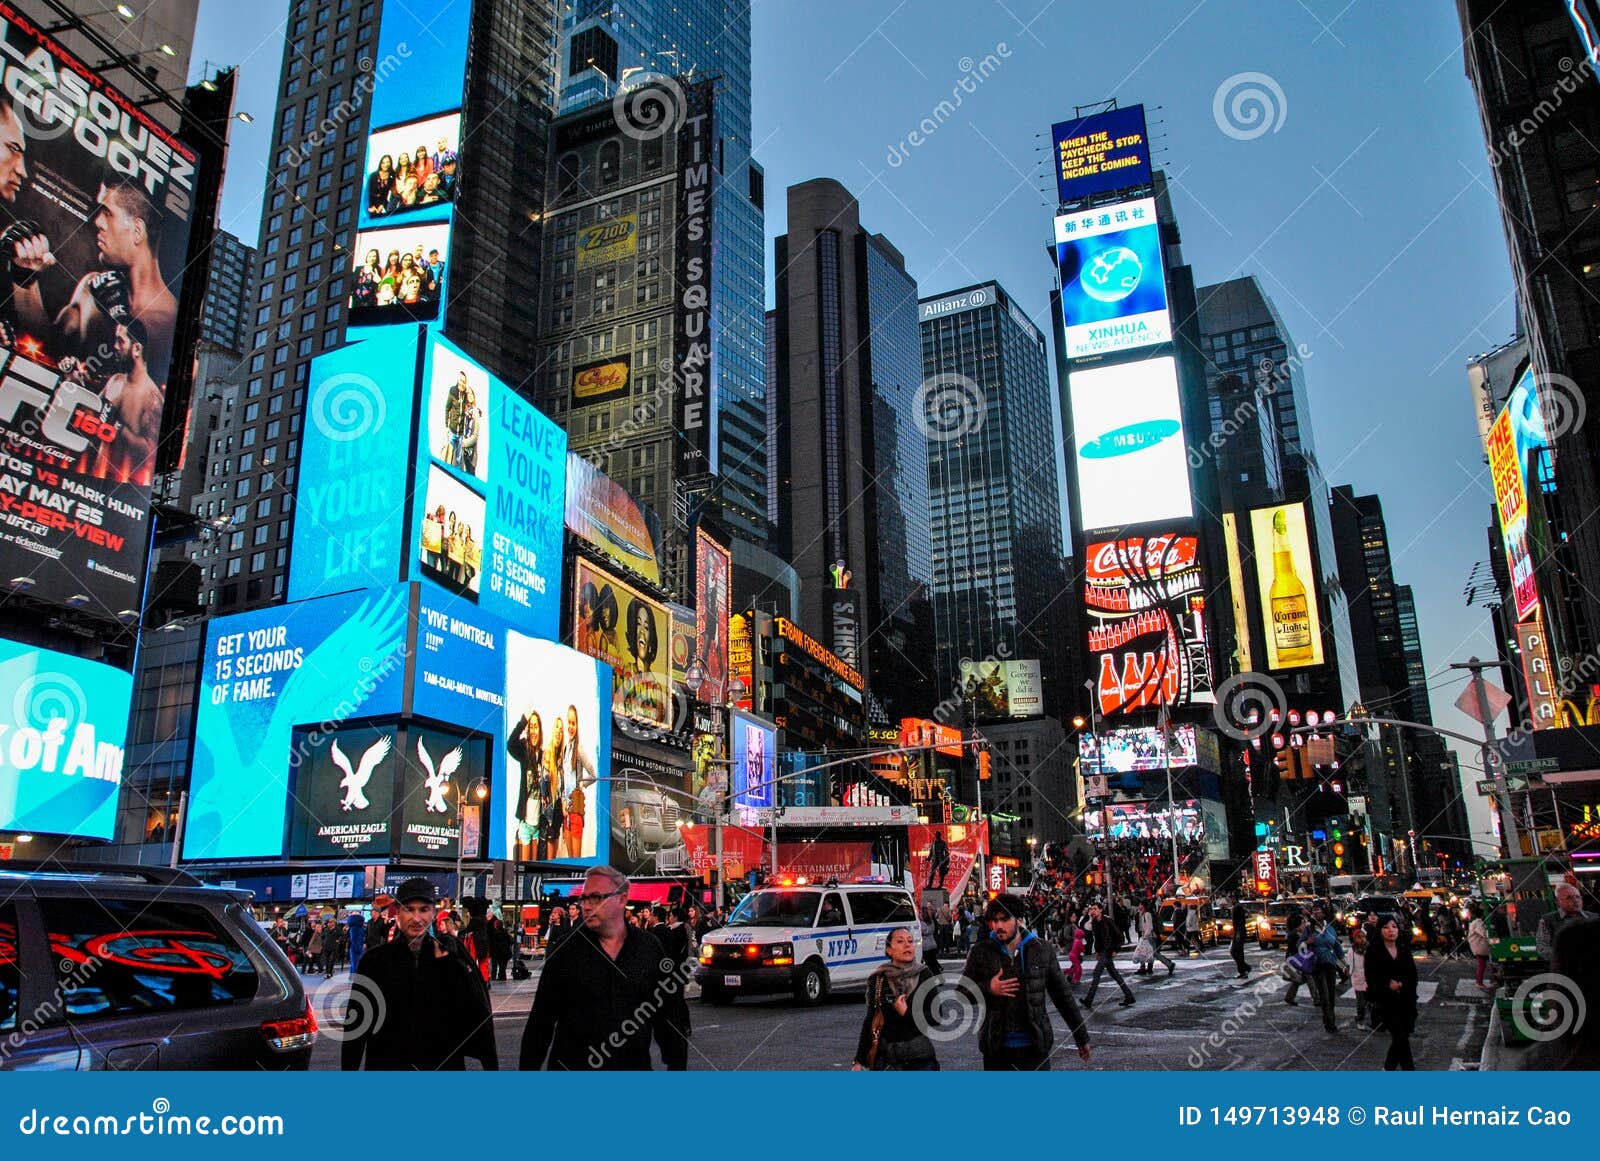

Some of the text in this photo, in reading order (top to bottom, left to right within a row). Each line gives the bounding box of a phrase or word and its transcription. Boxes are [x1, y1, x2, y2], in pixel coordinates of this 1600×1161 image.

[1059, 131, 1108, 150] WHEN THE
[1061, 140, 1114, 160] PAYCHECKS
[1061, 152, 1105, 170] KEEP THE
[1063, 155, 1141, 180] INCOME COMING.
[166, 181, 190, 222] 2
[1065, 207, 1145, 233] 新华通讯社
[92, 270, 117, 288] UFC
[683, 114, 708, 429] TIMES SQUARE
[924, 297, 967, 316] Allianz
[1076, 330, 1163, 354] NEWS AGENCY
[1088, 320, 1148, 341] XINHUA
[72, 408, 118, 443] 160
[501, 395, 553, 461] LEAVE
[1488, 413, 1511, 463] THE
[19, 436, 44, 450] BUD
[47, 446, 76, 463] LIGHT
[684, 449, 703, 461] NYC
[1493, 445, 1514, 480] CROWD
[506, 442, 552, 504] YOUR
[1496, 464, 1518, 502] GOES
[28, 484, 76, 514] MAY
[75, 502, 104, 526] 25
[36, 467, 59, 486] VS
[61, 478, 106, 505] MARK
[107, 497, 144, 521] HUNT
[308, 470, 391, 525] YOUR
[496, 487, 550, 547] MARK
[1500, 491, 1524, 526] WILD!
[15, 535, 64, 557] ticketmaster
[323, 530, 387, 579] LIFE
[493, 532, 537, 571] GET YOUR
[492, 552, 546, 595] 15 SECONDS
[491, 572, 532, 608] OF FAME.
[1273, 609, 1307, 623] Corona
[1282, 623, 1302, 634] Light
[218, 626, 287, 656] GET YOUR
[450, 619, 495, 650] MONTREAL
[215, 647, 303, 681] 15 SECONDS
[804, 634, 826, 663] FOREIGN
[825, 649, 849, 680] EXCHANGE
[212, 678, 276, 706] OF FAME.
[1527, 634, 1557, 730] PALA
[10, 717, 67, 773] of
[318, 823, 387, 836] AMERICAN EAGLE
[331, 834, 372, 843] OUTFITTERS
[407, 824, 440, 837] AMERICAN
[417, 835, 449, 845] OUTFITTERS
[693, 858, 744, 869] REVON
[774, 863, 851, 873] NTERTAINMENT
[1257, 853, 1271, 880] tkts
[1286, 845, 1310, 866] R
[991, 865, 1001, 891] tkts
[827, 938, 858, 957] NYPD
